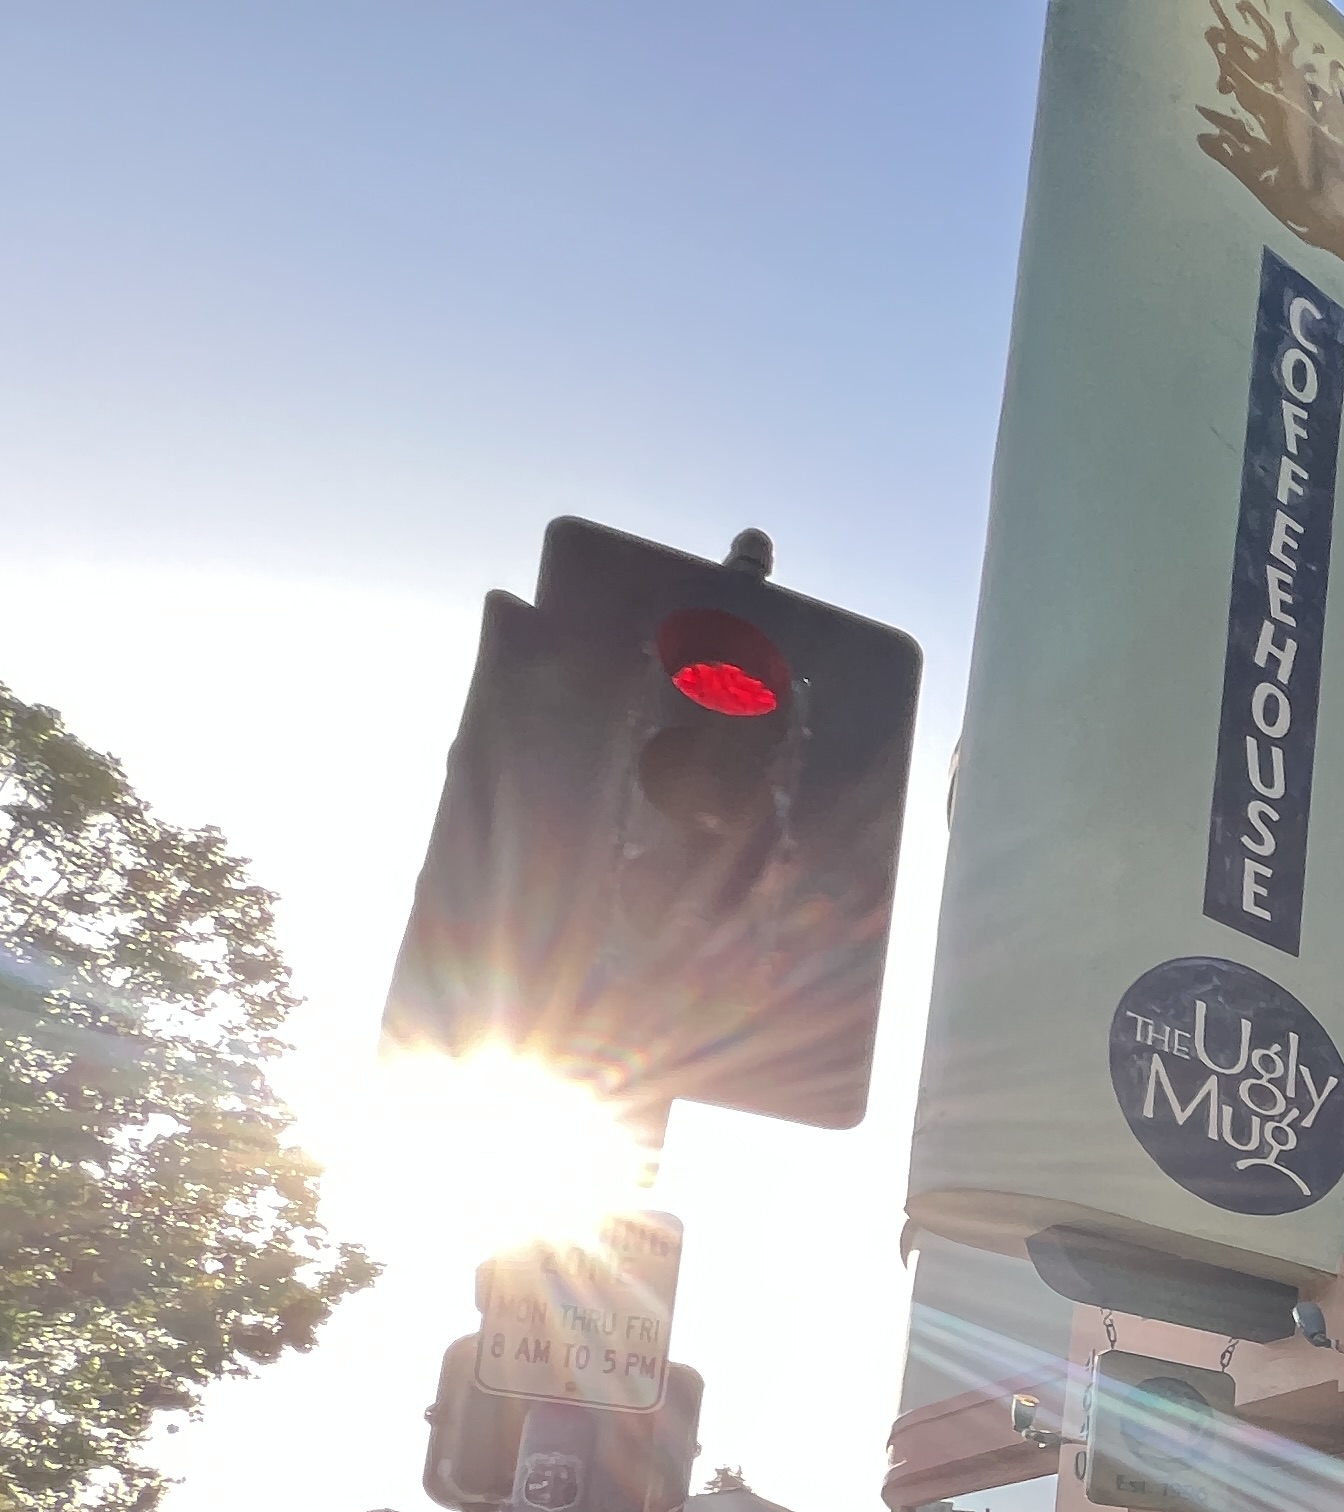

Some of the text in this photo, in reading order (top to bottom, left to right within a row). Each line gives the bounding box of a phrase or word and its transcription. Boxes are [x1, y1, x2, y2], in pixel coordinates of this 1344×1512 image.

[1239, 296, 1323, 922] COFFEEHOUSE
[1126, 1000, 1339, 1128] THE Ugly
[1142, 1053, 1312, 1196] Mug
[491, 1332, 656, 1379] 8 AM TO 5 PM
[561, 1303, 617, 1336] THRU
[626, 1316, 660, 1343] FRI
